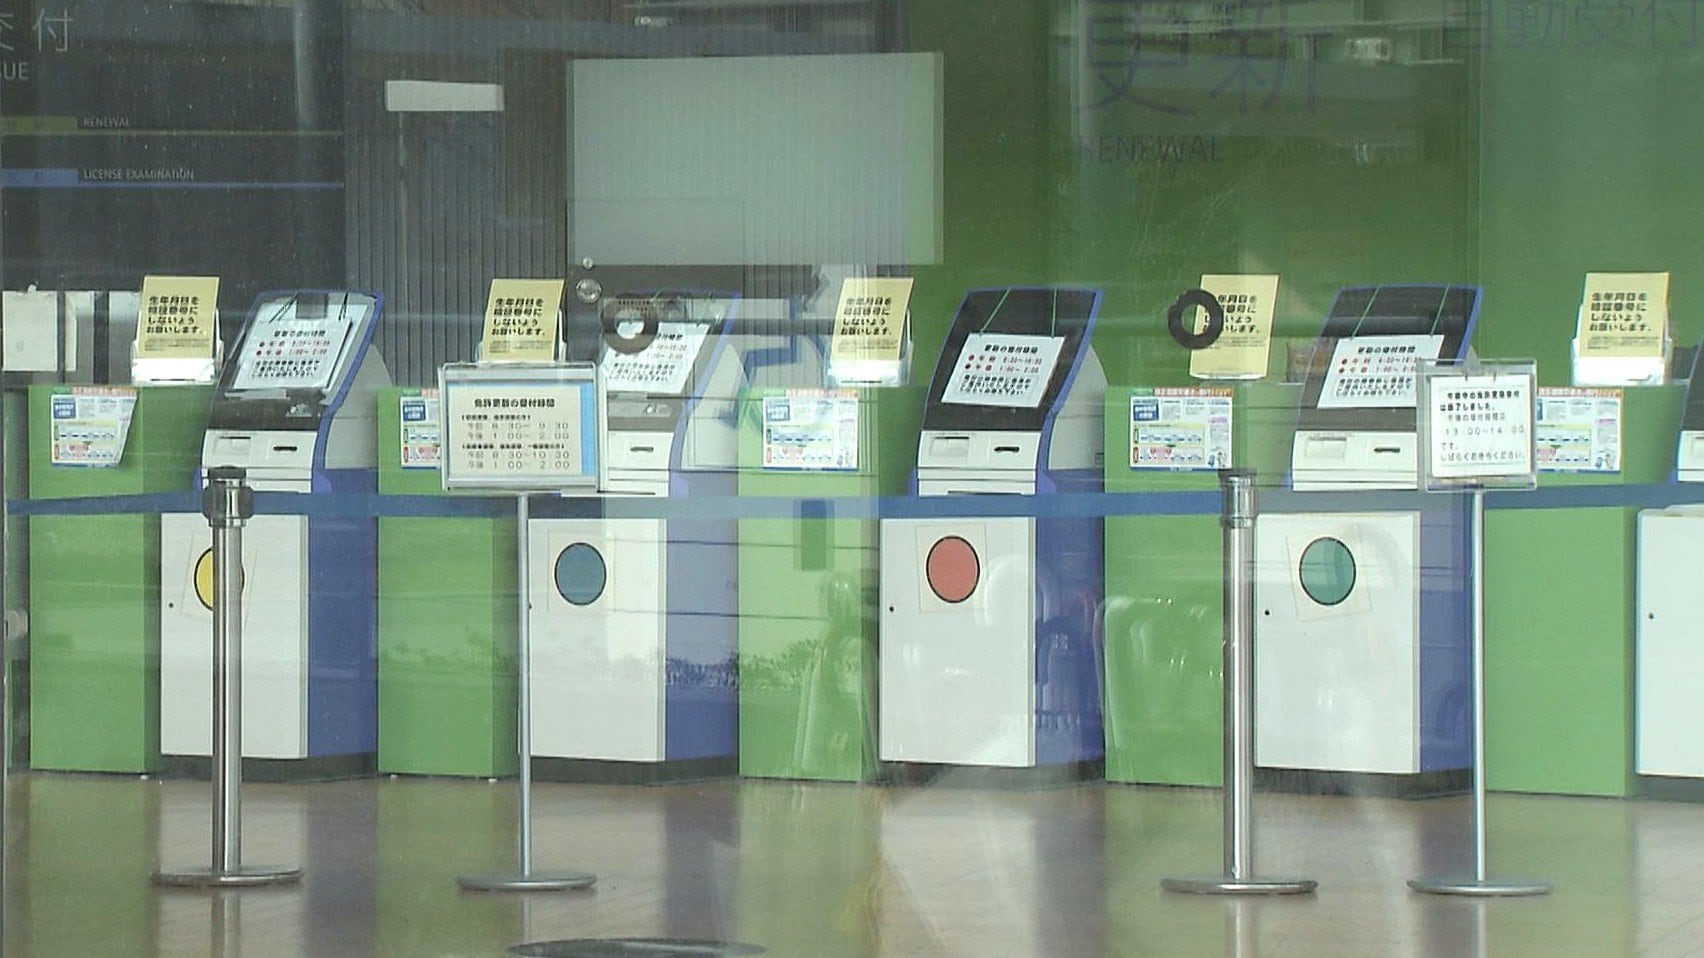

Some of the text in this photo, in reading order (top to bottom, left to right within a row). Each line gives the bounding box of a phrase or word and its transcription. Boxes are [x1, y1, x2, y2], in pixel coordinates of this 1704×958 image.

[0, 61, 29, 80] UE
[83, 116, 131, 128] RENEWAL
[83, 167, 195, 180] LICENSE EXAMINATION
